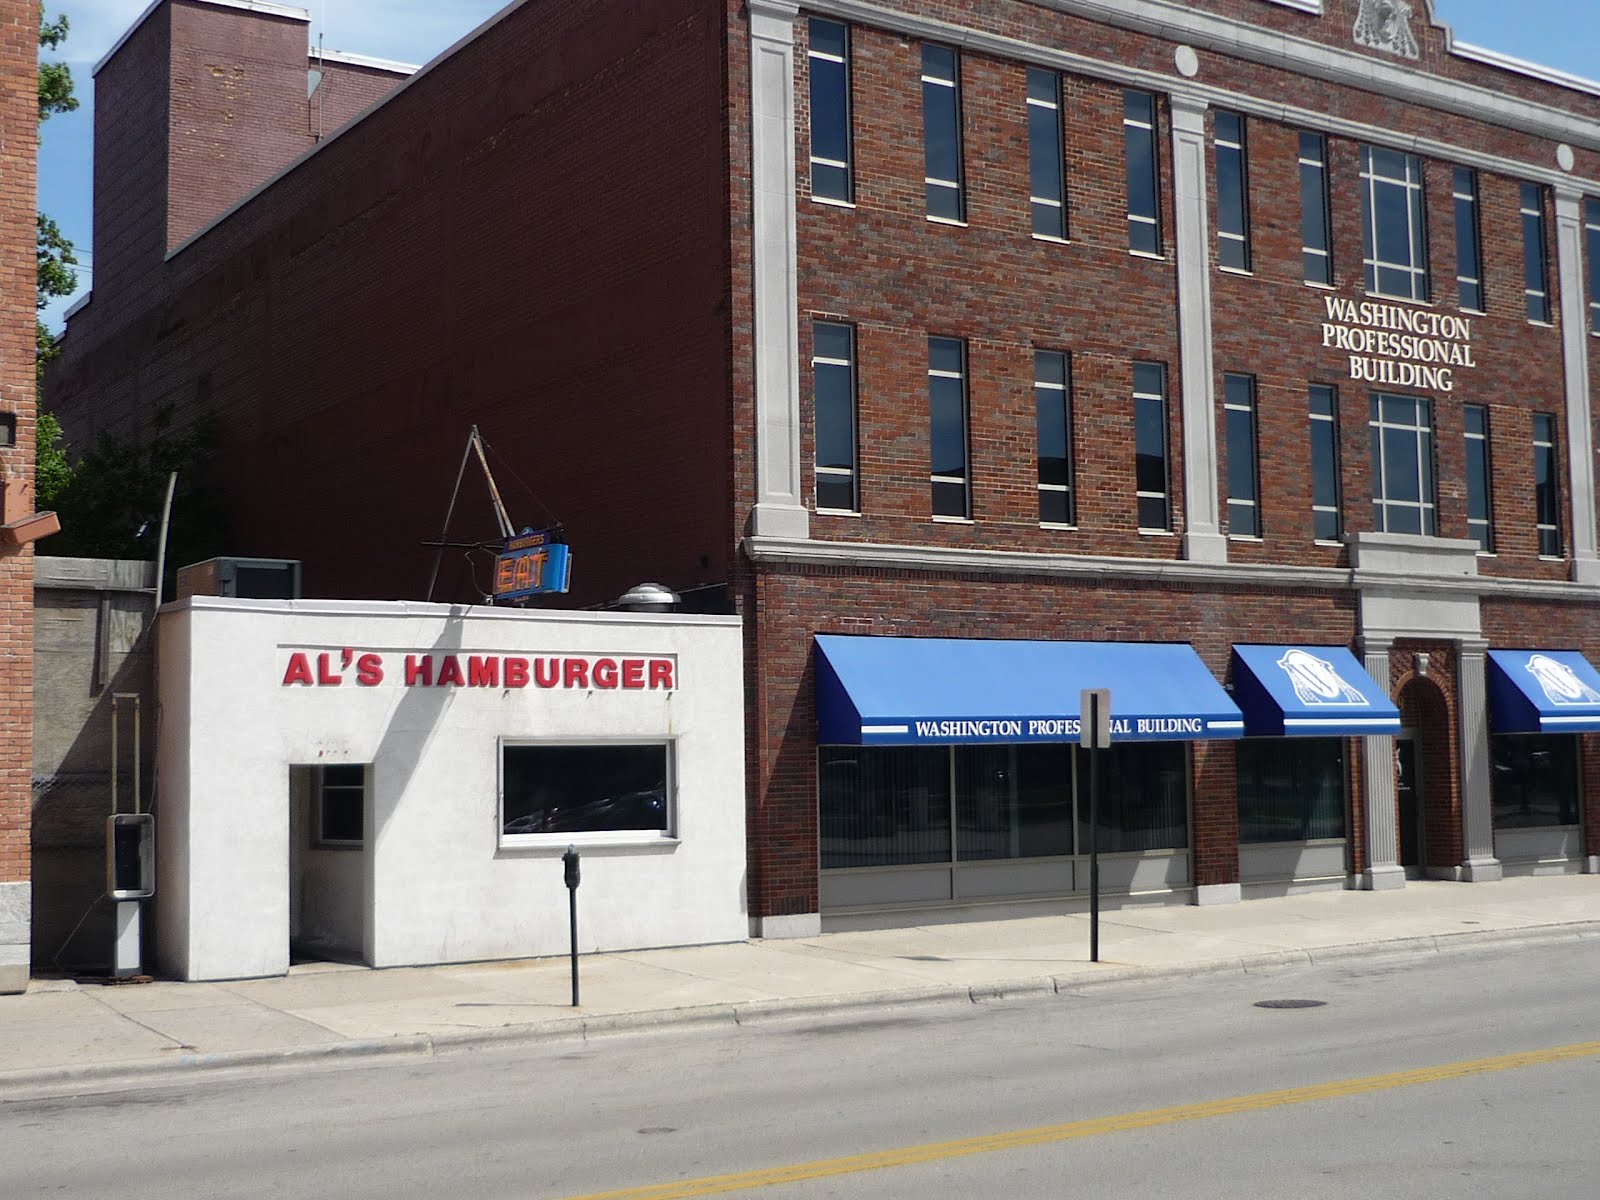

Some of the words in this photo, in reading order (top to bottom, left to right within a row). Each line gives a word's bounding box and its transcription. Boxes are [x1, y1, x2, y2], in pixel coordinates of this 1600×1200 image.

[1324, 296, 1470, 340] WASHINGTON
[1322, 323, 1476, 367] PROFESSIONAL
[1349, 355, 1453, 391] BUILDING
[496, 552, 548, 592] EAT
[282, 647, 384, 686] AL'S
[404, 655, 673, 689] HAMBURGER
[915, 719, 1022, 737] WASHINGTON
[1028, 719, 1132, 735] PROFESAL
[1137, 718, 1202, 733] BUILDING
